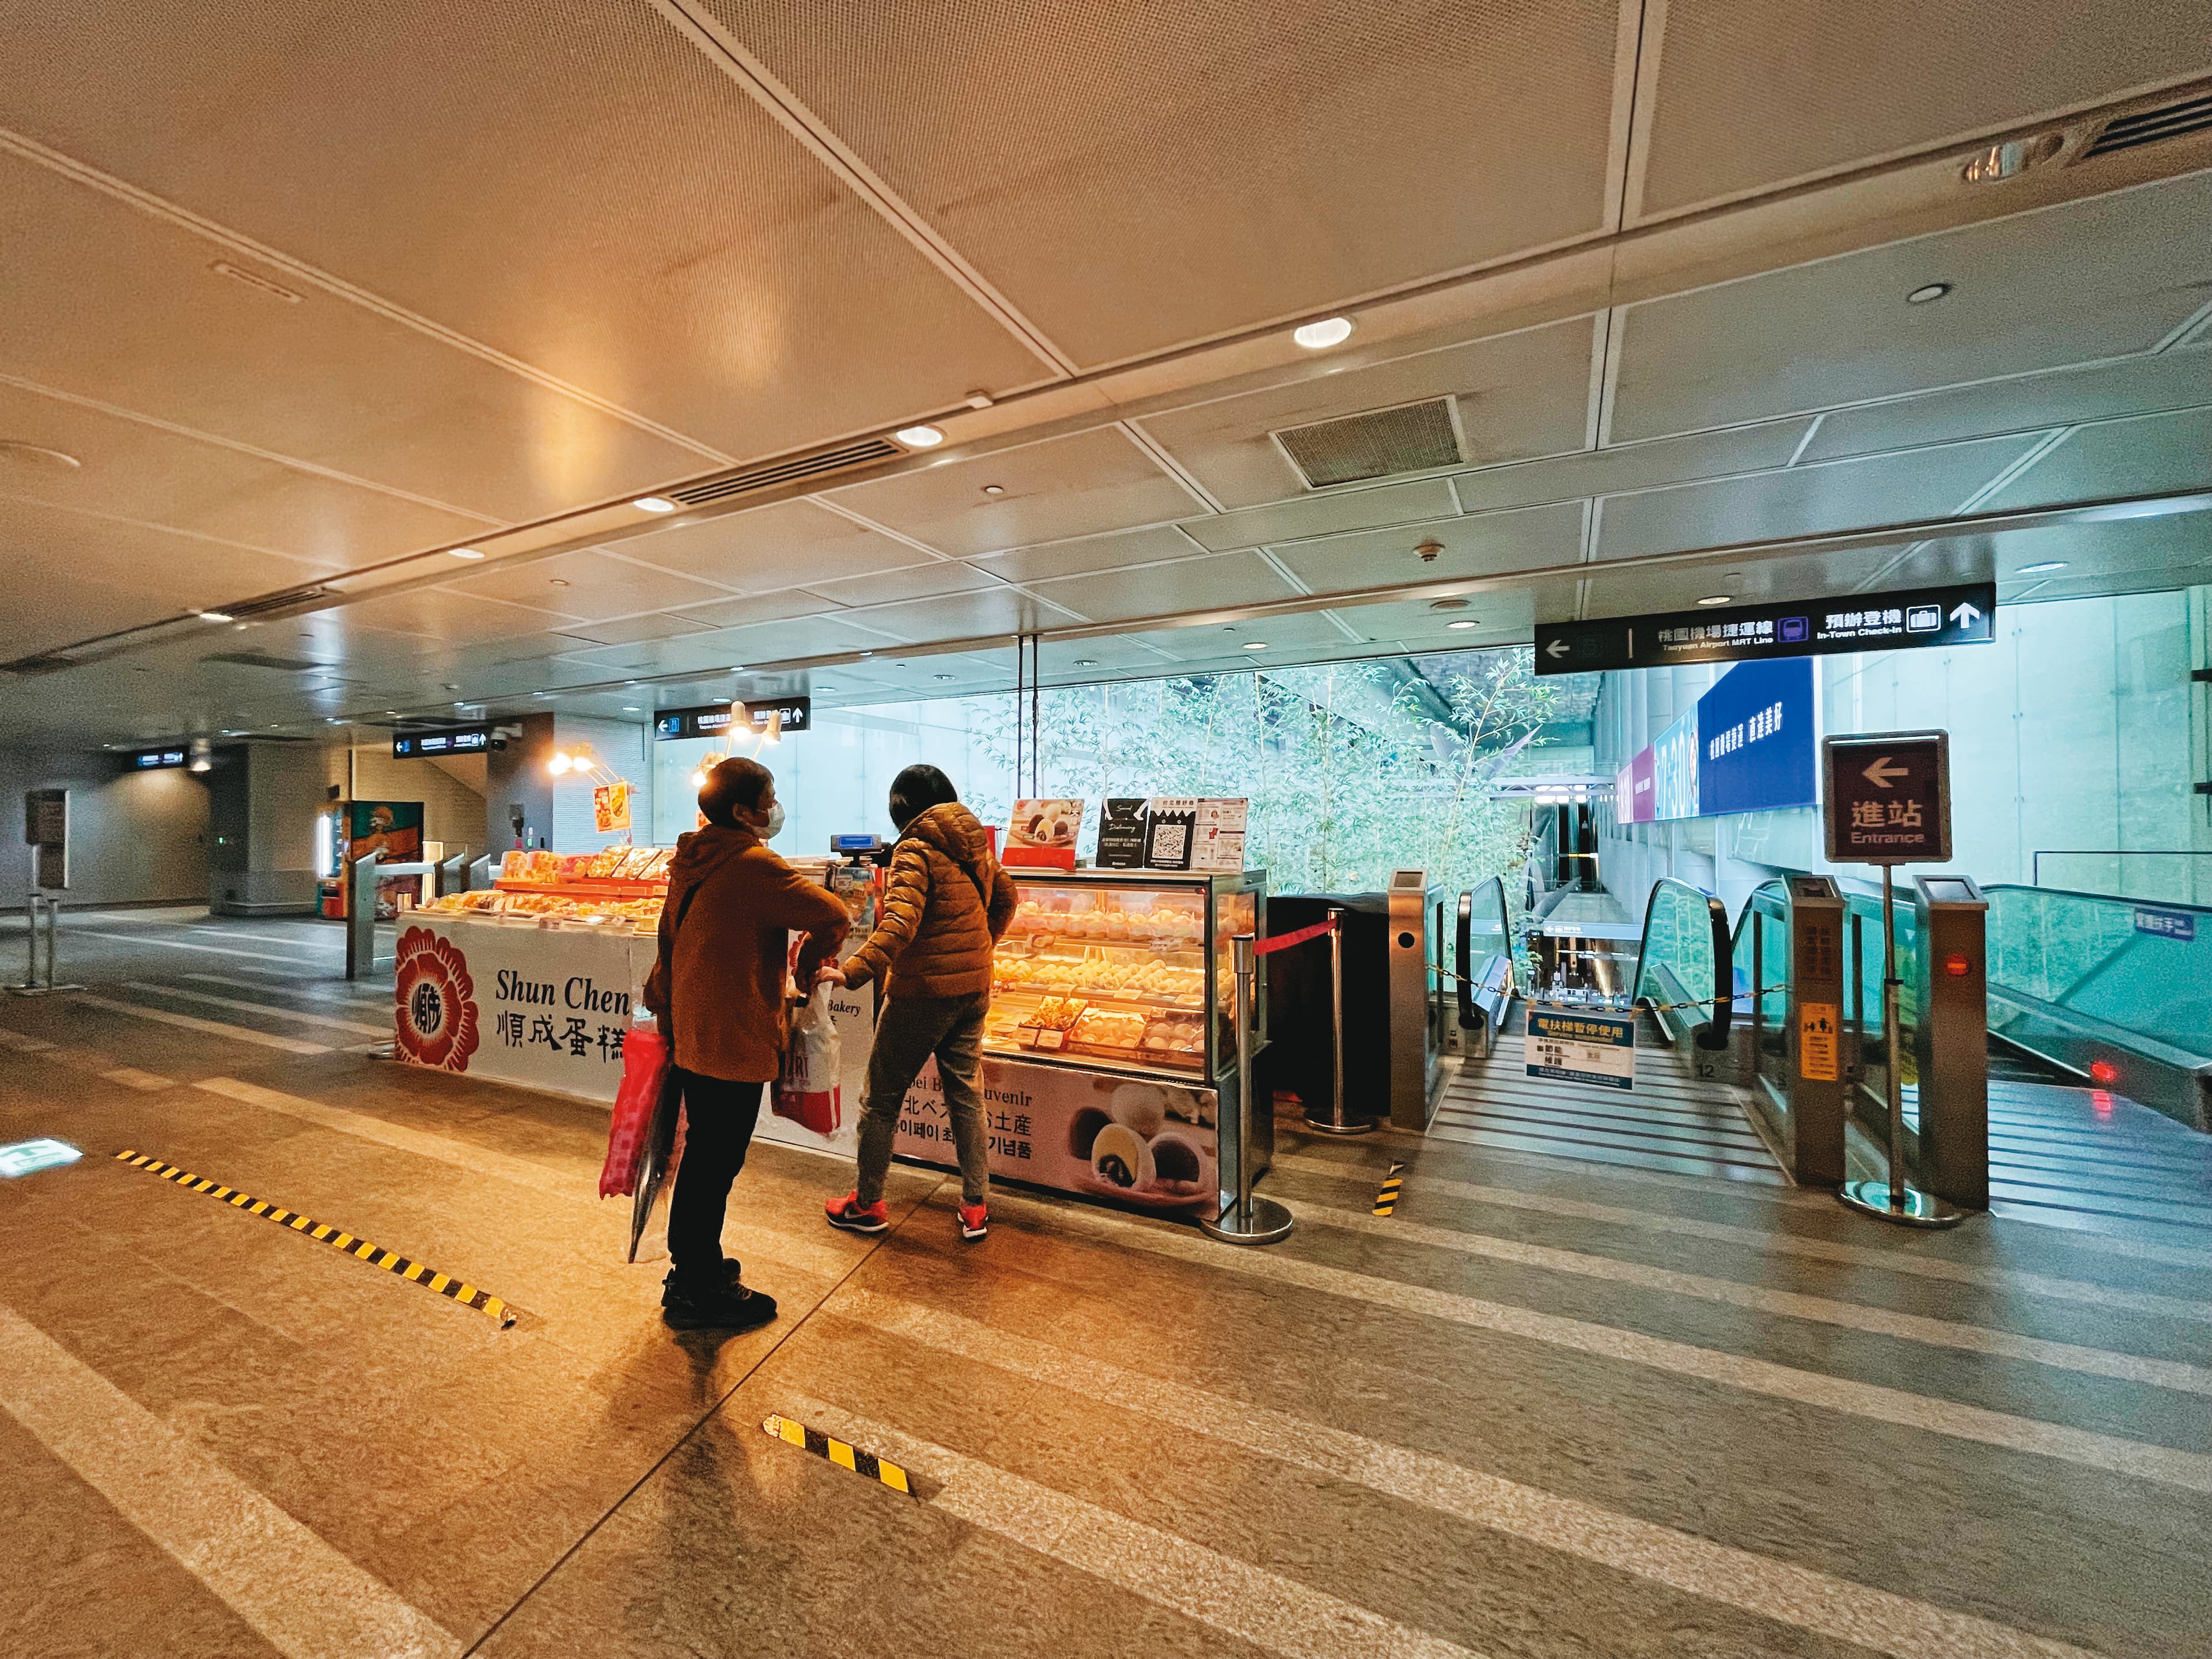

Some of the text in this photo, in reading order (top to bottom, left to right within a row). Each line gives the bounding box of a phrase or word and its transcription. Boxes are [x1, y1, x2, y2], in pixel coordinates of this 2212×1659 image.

[1658, 609, 1902, 642] 桃園機場捷運線 預辦登機
[1663, 626, 1903, 652] Taoyuan Airport MRT Line In-Town Check-in
[1852, 799, 1923, 827] 進站
[1851, 832, 1925, 844] Entrance
[495, 969, 630, 1016] Shun Chen
[828, 999, 861, 1017] Bakery
[497, 1010, 627, 1063] 順成蛋糕
[1537, 1018, 1623, 1038] 電扶梯暫停使用
